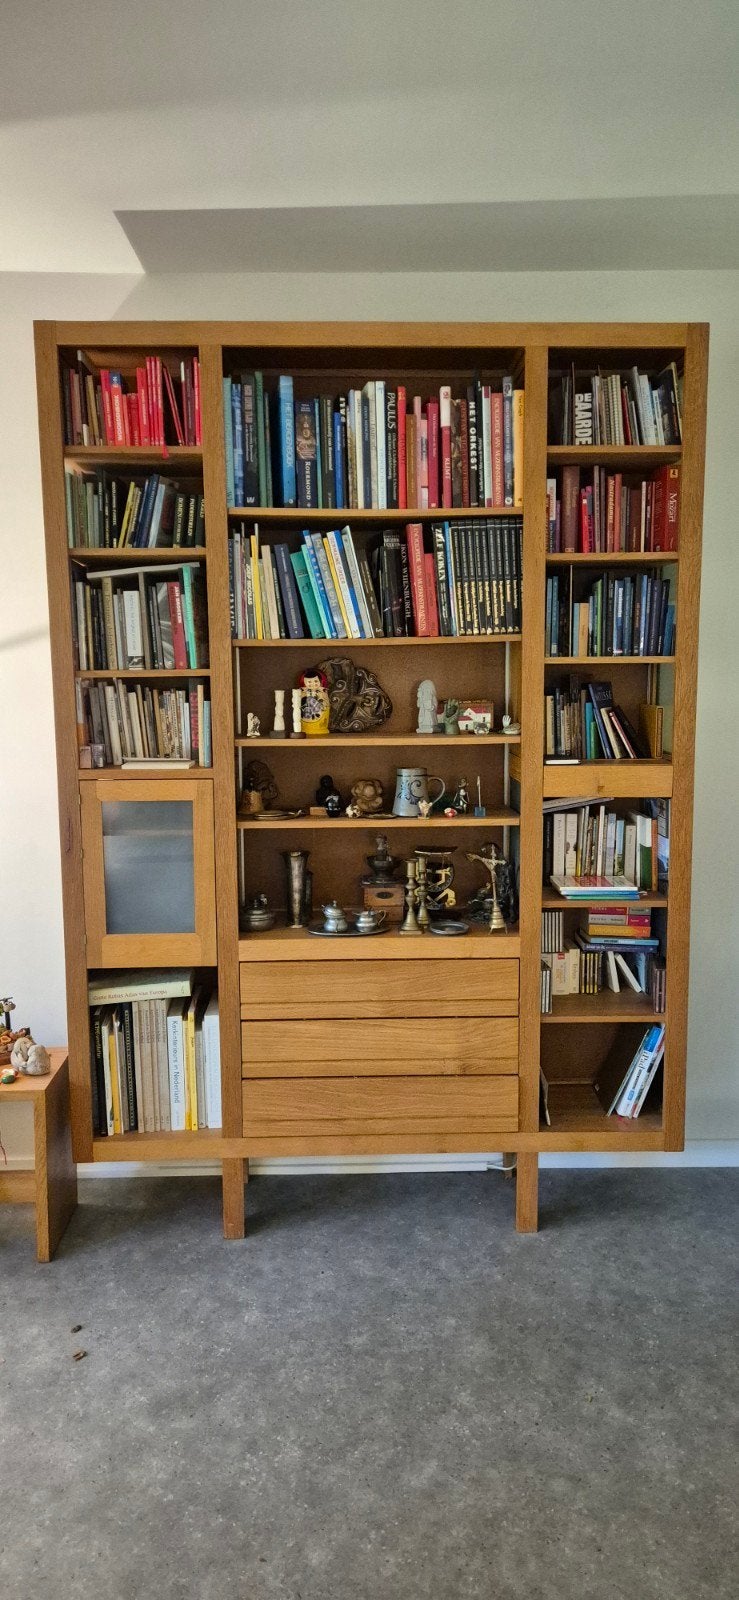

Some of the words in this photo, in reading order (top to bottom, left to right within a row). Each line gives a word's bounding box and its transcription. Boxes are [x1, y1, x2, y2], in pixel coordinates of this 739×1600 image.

[387, 392, 396, 429] PAULUS
[575, 392, 592, 402] DE
[575, 402, 592, 445] AARDE
[470, 428, 478, 471] ORKEST
[668, 492, 678, 522] Mozart
[435, 528, 445, 550] ZELF
[437, 552, 446, 580] KOKEN
[171, 1020, 179, 1063] Kerkinterieurs
